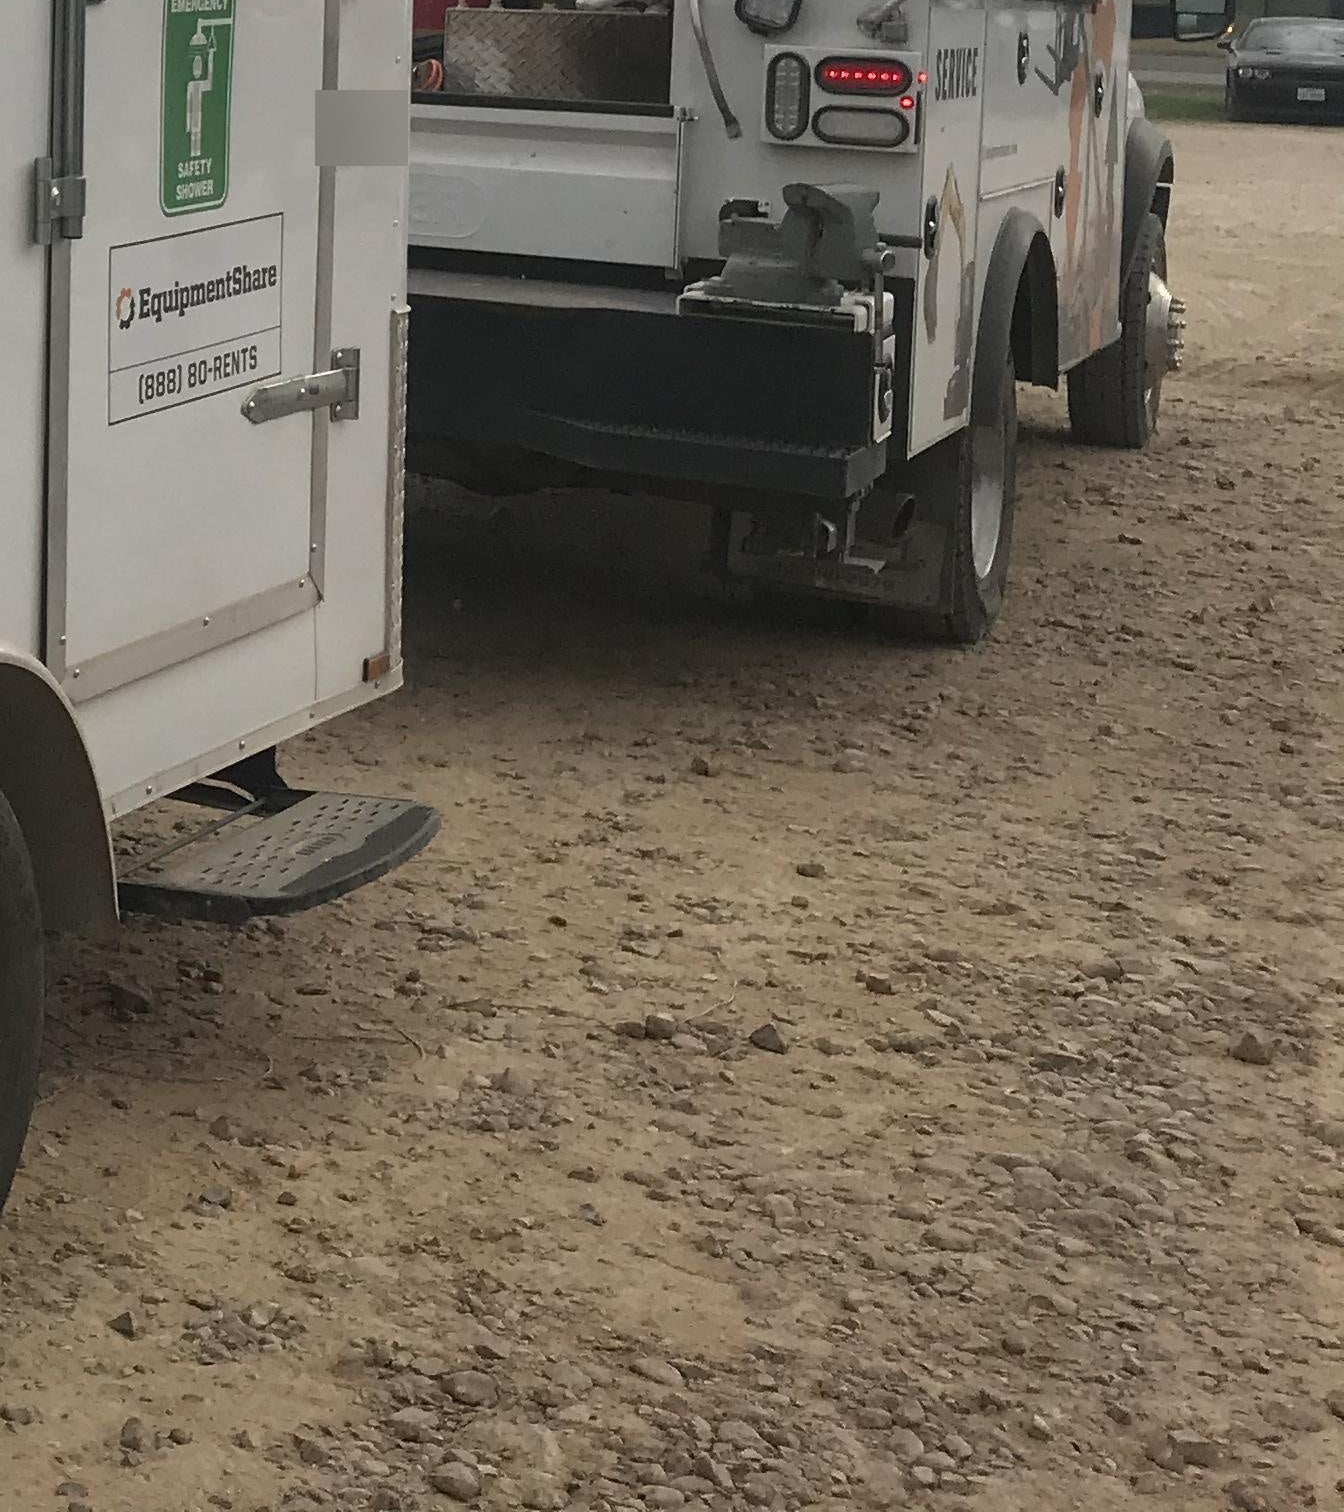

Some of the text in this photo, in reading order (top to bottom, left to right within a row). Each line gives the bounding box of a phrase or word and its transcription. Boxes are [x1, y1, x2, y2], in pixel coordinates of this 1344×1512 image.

[935, 47, 978, 101] SERVICE
[175, 179, 214, 200] SHOWER
[177, 157, 212, 178] SAFETY
[138, 264, 277, 323] EquipmentShare
[138, 345, 258, 404] (888) 80-RENTS
